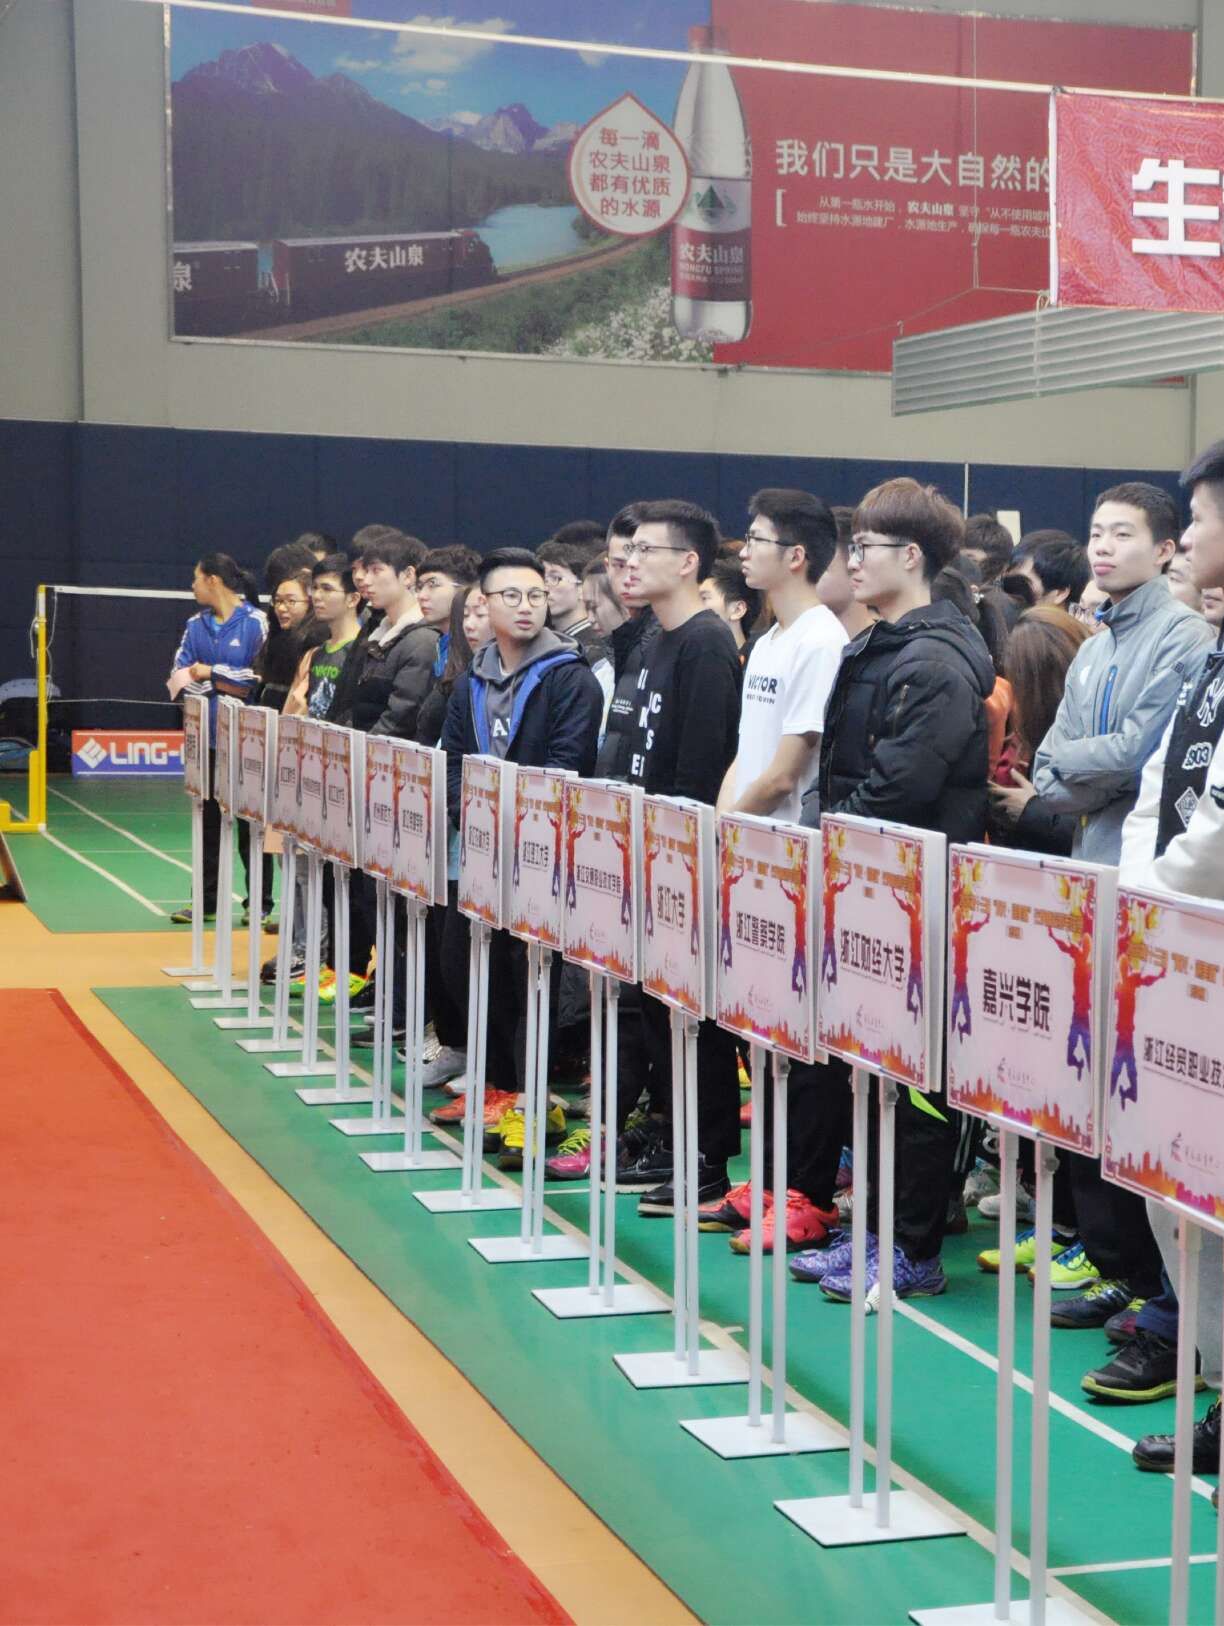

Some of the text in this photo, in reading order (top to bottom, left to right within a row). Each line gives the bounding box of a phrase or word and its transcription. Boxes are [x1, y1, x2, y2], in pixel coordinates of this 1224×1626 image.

[600, 127, 660, 151] 每一滴
[589, 150, 671, 174] 农夫山泉
[776, 139, 1050, 192] 我们只是大自然的
[589, 174, 671, 197] 都有优质
[600, 197, 660, 218] 的水源
[345, 244, 424, 272] 农夫山泉
[679, 243, 744, 264] 农夫山泉
[748, 674, 777, 694] VICTOR
[657, 884, 685, 928] 浙江大学
[840, 928, 905, 982] 浙江财经大学
[983, 968, 1050, 1032] 嘉兴学院
